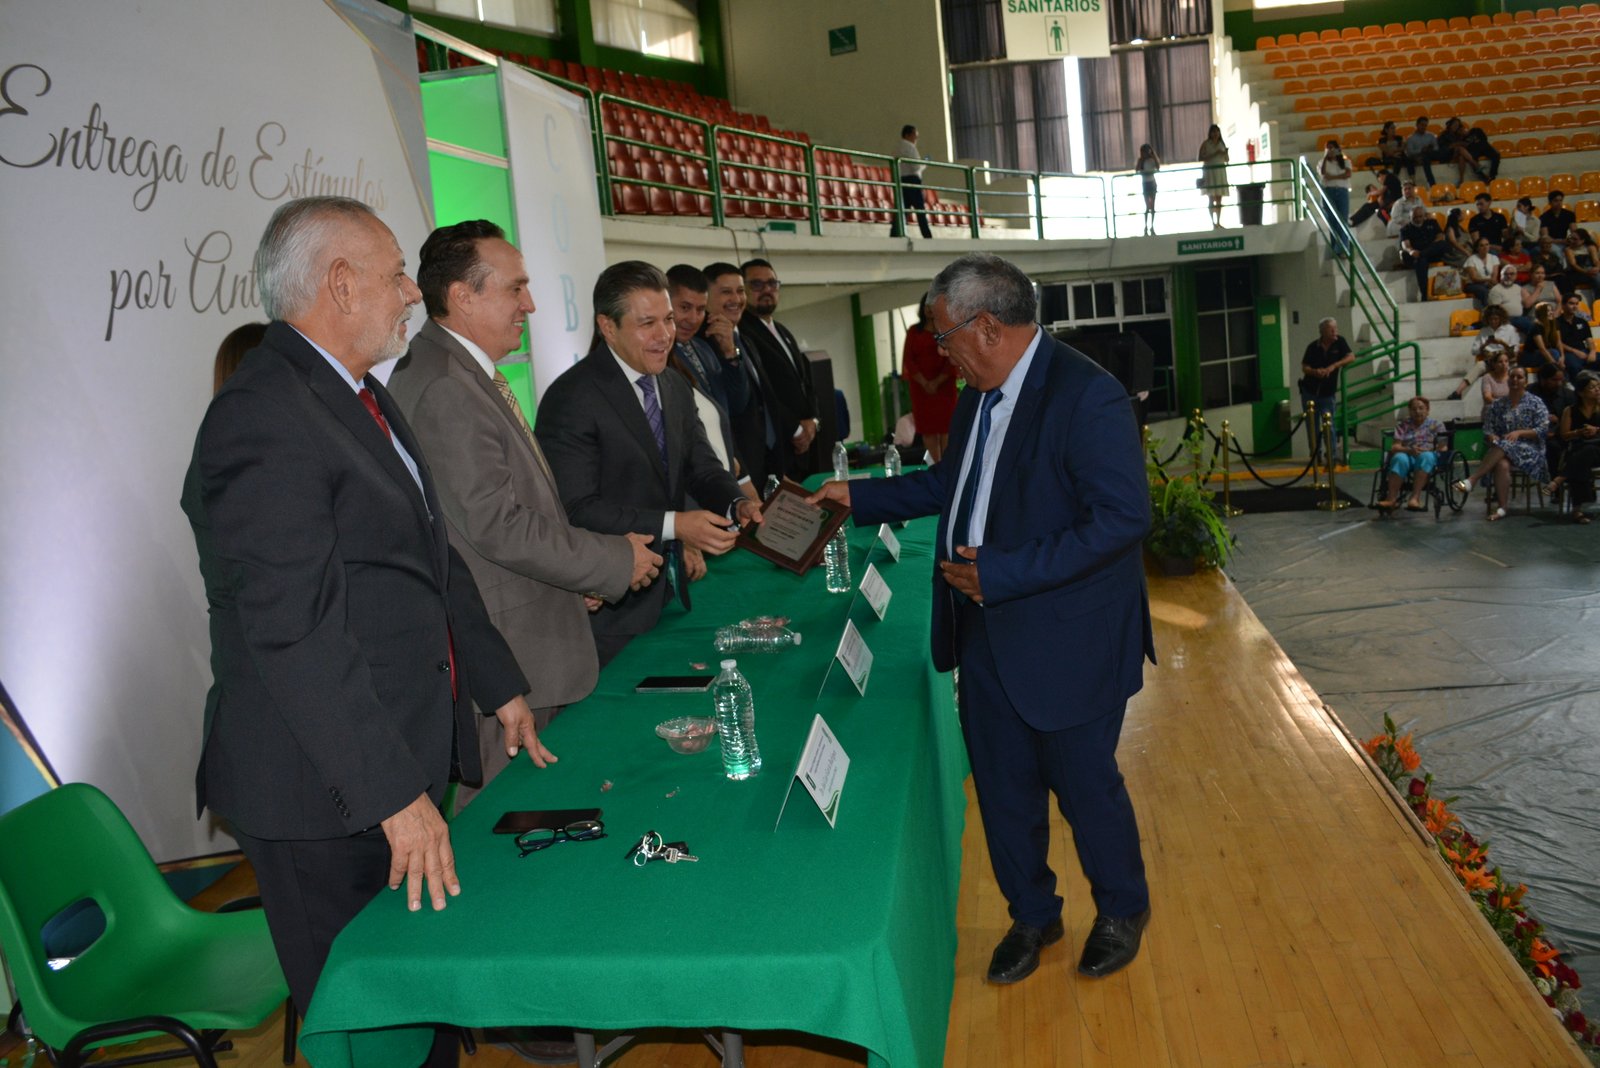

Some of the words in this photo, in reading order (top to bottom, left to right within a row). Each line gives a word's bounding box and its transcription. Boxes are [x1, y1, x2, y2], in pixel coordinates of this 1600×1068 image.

[1008, 0, 1100, 13] SANITARIOS
[0, 63, 188, 212] Entrega
[201, 126, 239, 191] de
[250, 121, 386, 211] Estímulos
[1182, 240, 1233, 251] SANITARIOS
[105, 259, 176, 341] por
[184, 230, 262, 315] Ant
